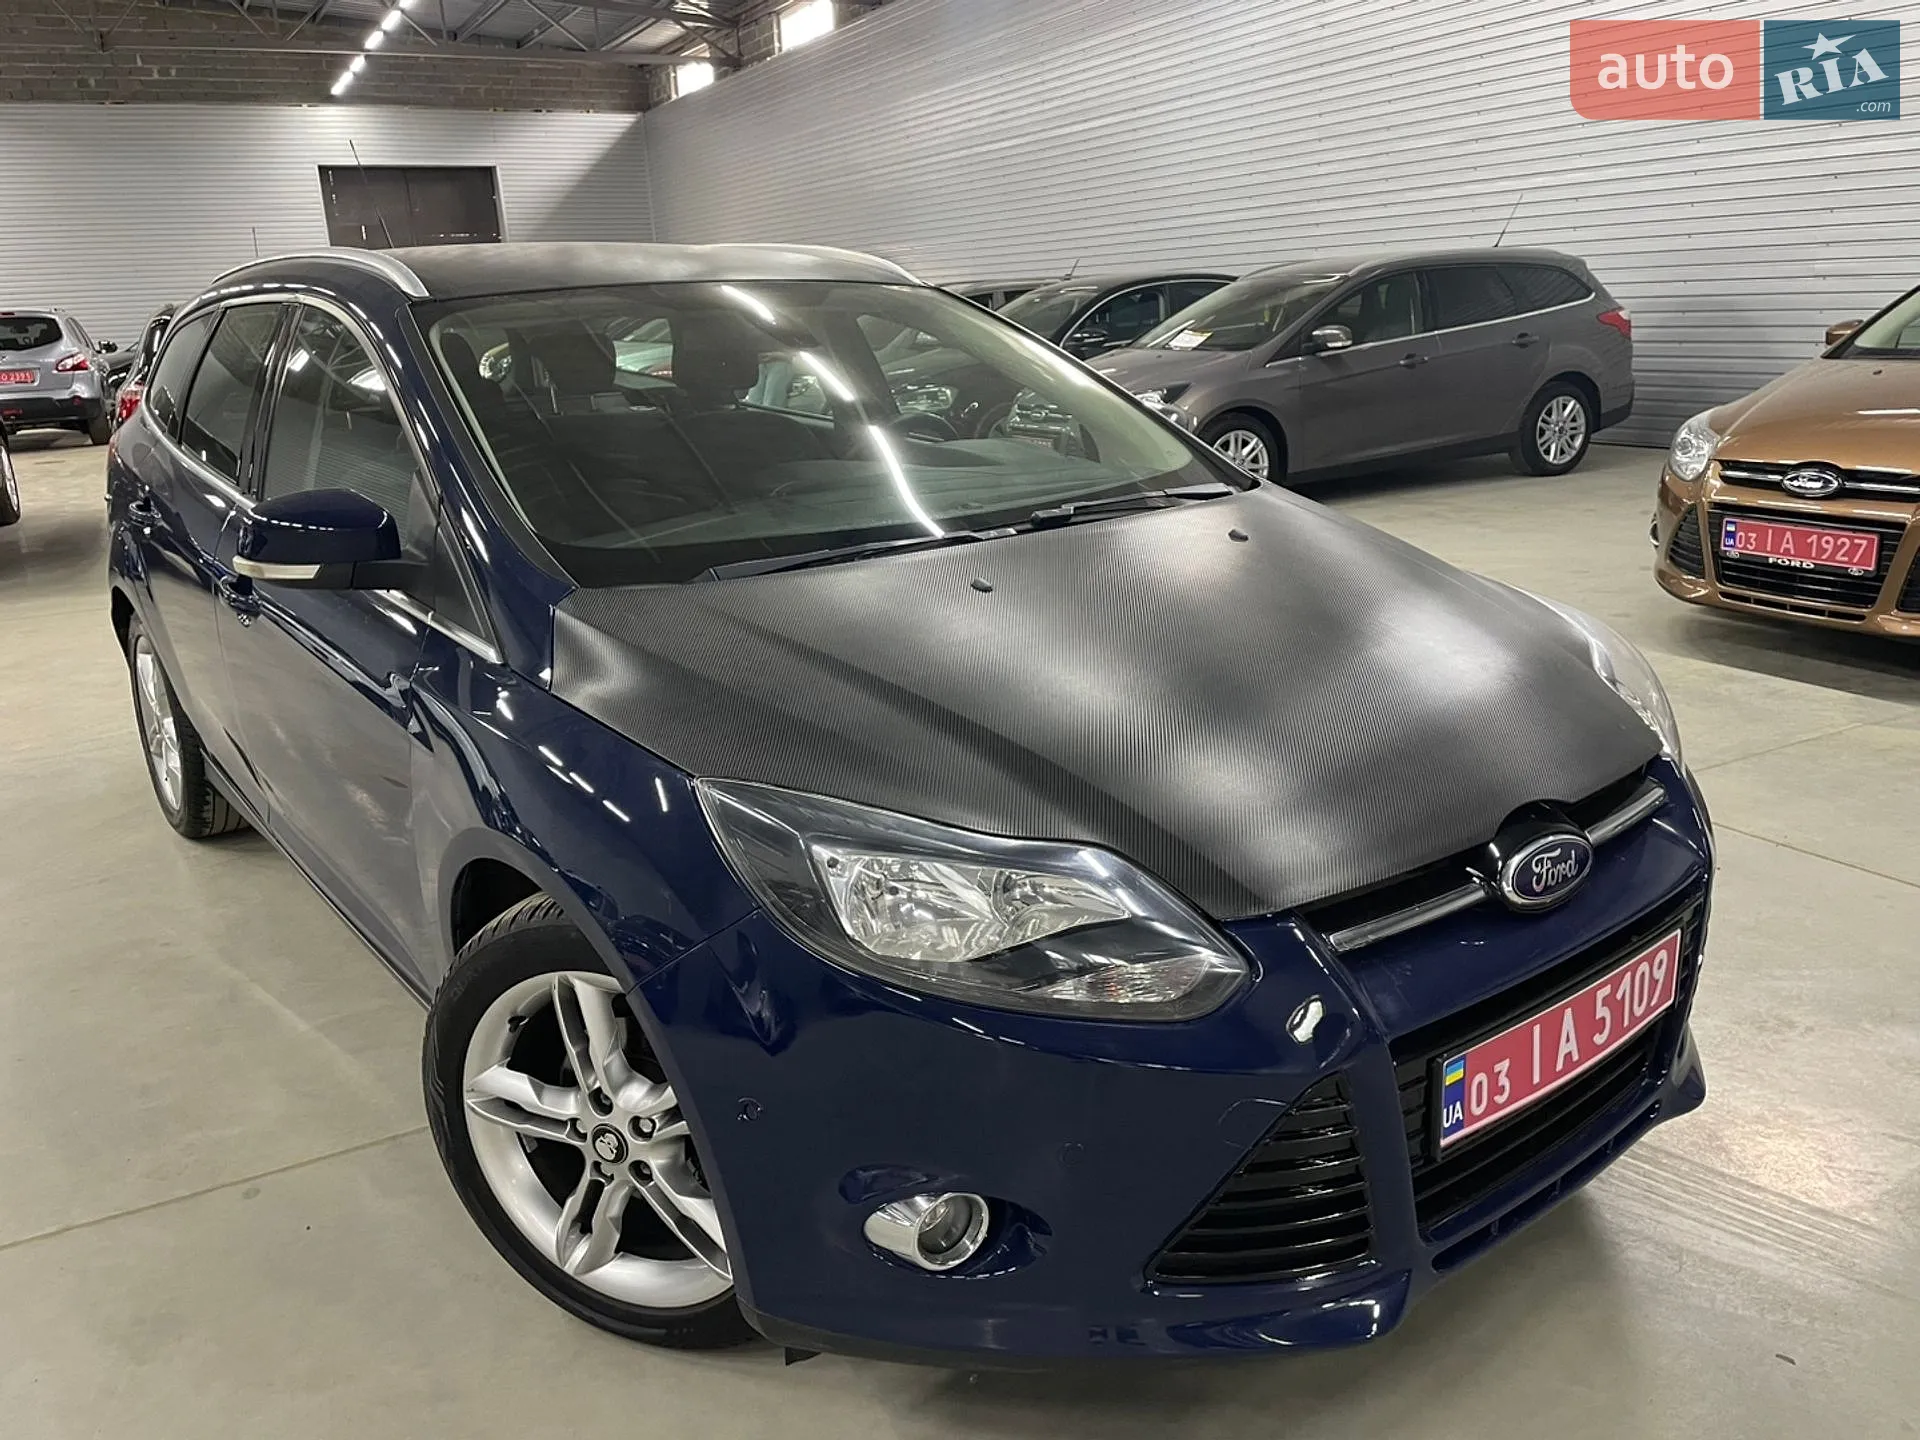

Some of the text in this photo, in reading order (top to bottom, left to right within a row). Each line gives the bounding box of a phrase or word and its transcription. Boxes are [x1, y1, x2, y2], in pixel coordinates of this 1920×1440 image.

[1736, 531, 1757, 550] 03
[1806, 534, 1868, 564] 1927
[1768, 557, 1815, 568] FORD
[1531, 848, 1579, 893] Ford
[1470, 1058, 1512, 1117] 03
[1592, 949, 1669, 1046] 5109
[1443, 1101, 1464, 1128] UA
